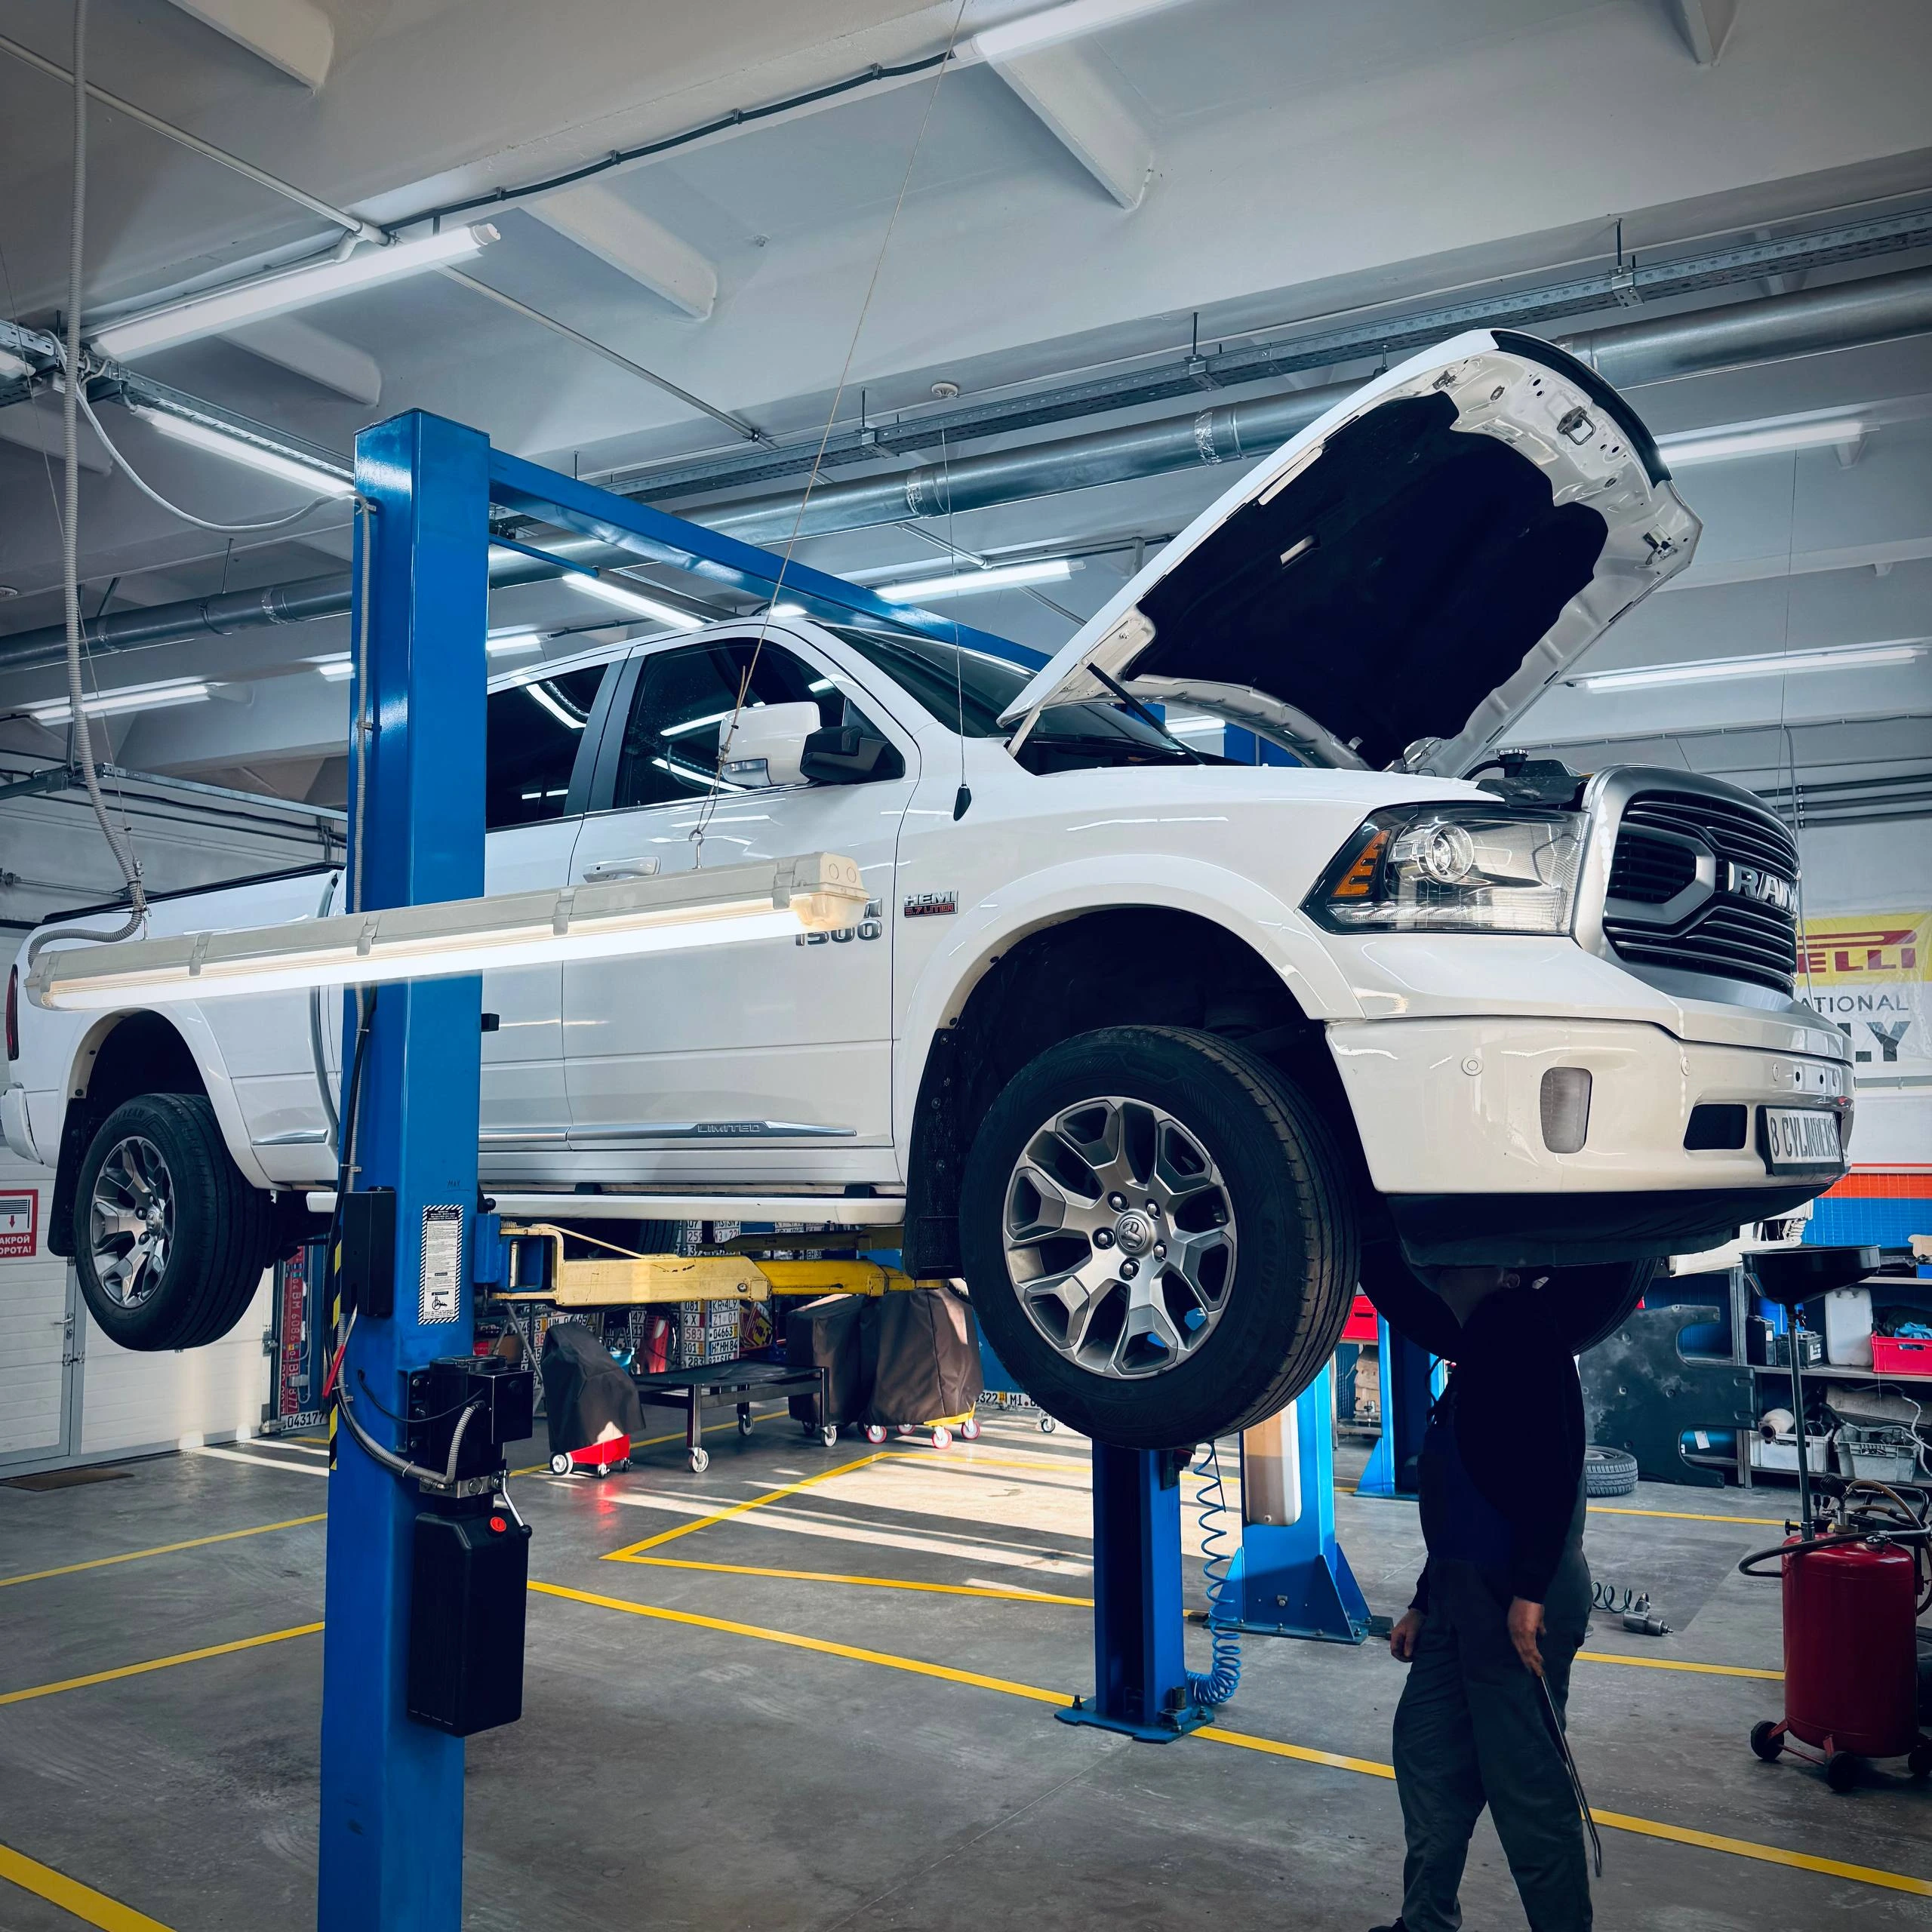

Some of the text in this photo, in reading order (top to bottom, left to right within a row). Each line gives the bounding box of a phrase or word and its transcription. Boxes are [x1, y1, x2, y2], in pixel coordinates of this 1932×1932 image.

[1728, 861, 1798, 912] RAM
[904, 891, 958, 906] HEMI
[905, 903, 954, 915] 5.7 LITER
[697, 1123, 760, 1133] LIMITED
[1770, 1117, 1839, 1158] 8 CYLINDERS
[0, 1235, 30, 1244] АКРОЙ
